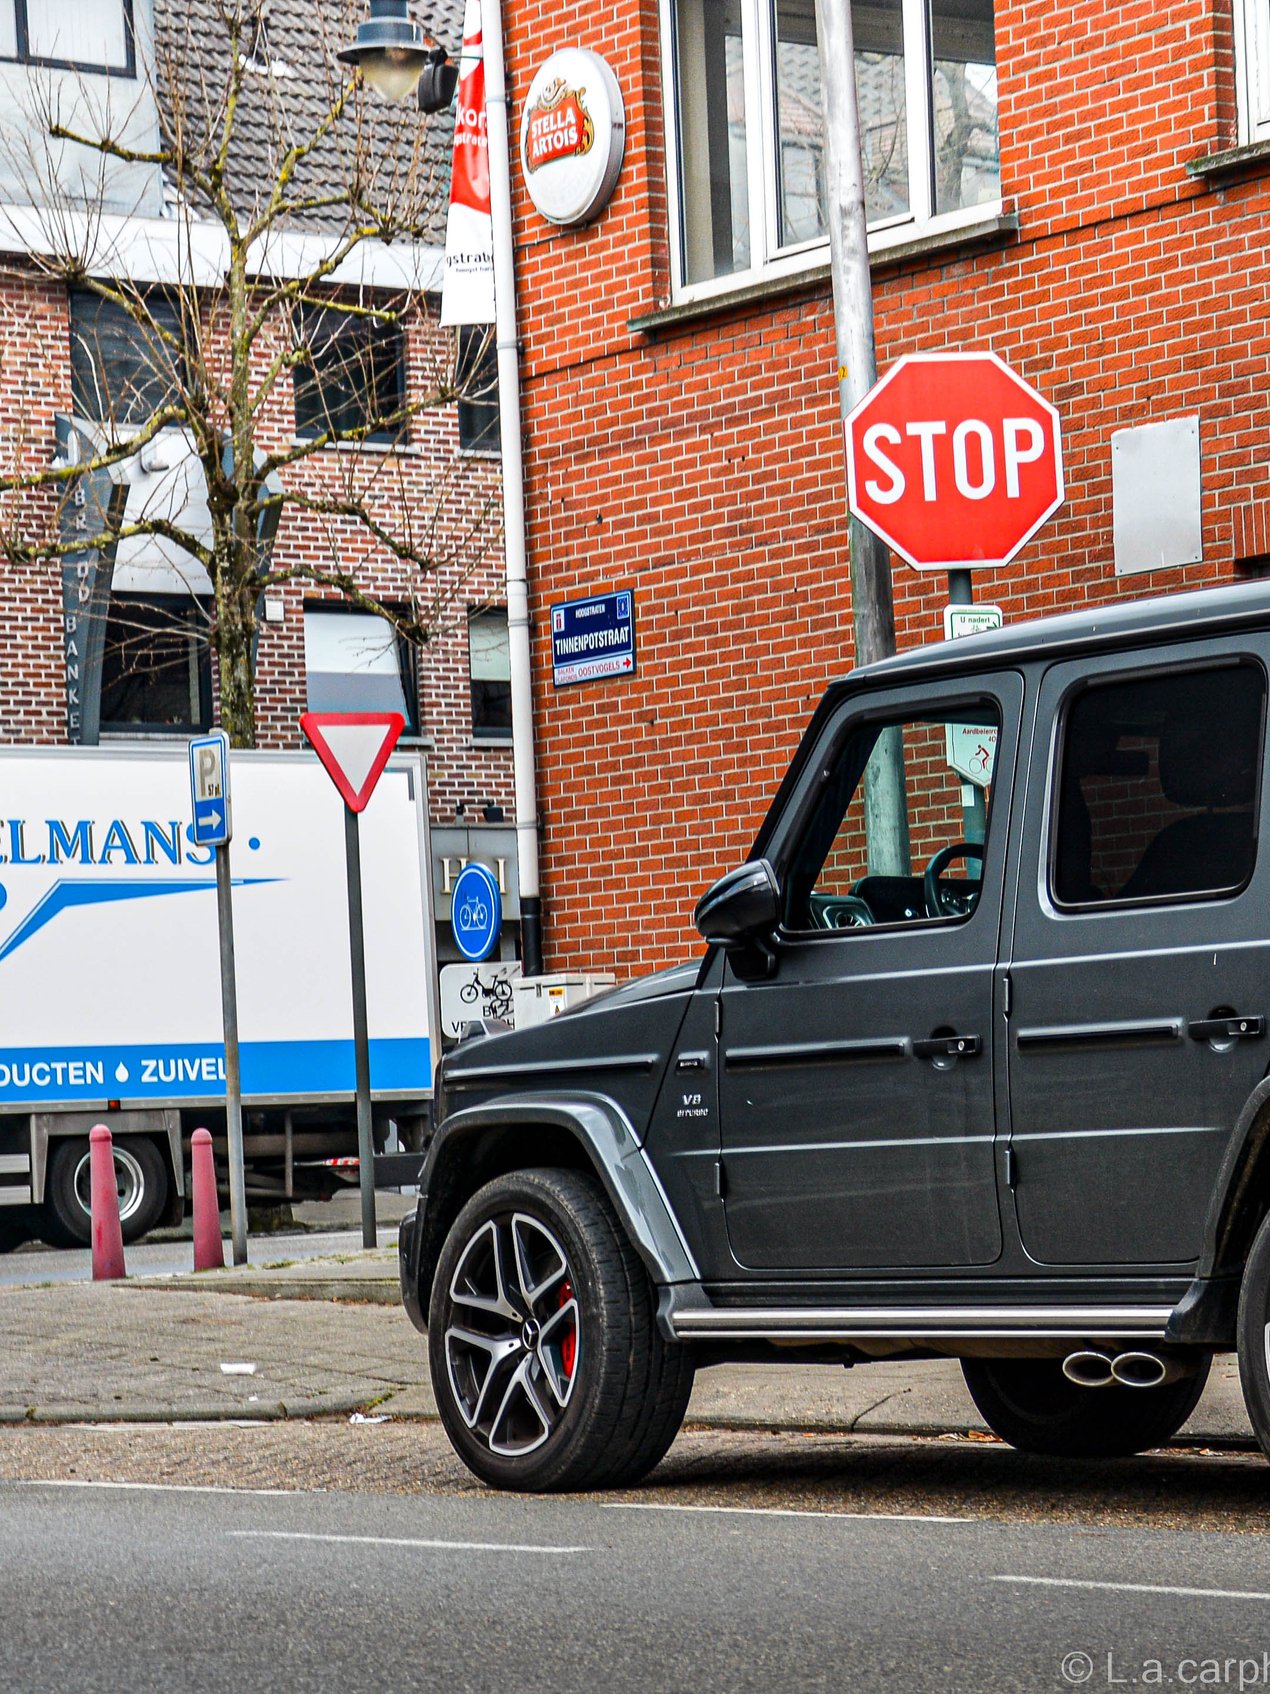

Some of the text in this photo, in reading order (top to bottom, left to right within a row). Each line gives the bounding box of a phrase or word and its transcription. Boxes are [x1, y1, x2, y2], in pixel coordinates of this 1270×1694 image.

[531, 107, 576, 139] STELLA
[532, 126, 579, 158] ARTOIS
[863, 417, 1045, 505] STOP
[575, 604, 605, 618] HOOGSTRATEN
[555, 626, 629, 656] TINNENPOTSTRAAT
[578, 661, 620, 677] OOSTVOGELS
[199, 749, 216, 797] P
[0, 819, 217, 867] LMANS
[140, 1057, 227, 1083] ZUIVEL
[683, 1094, 701, 1105] V8
